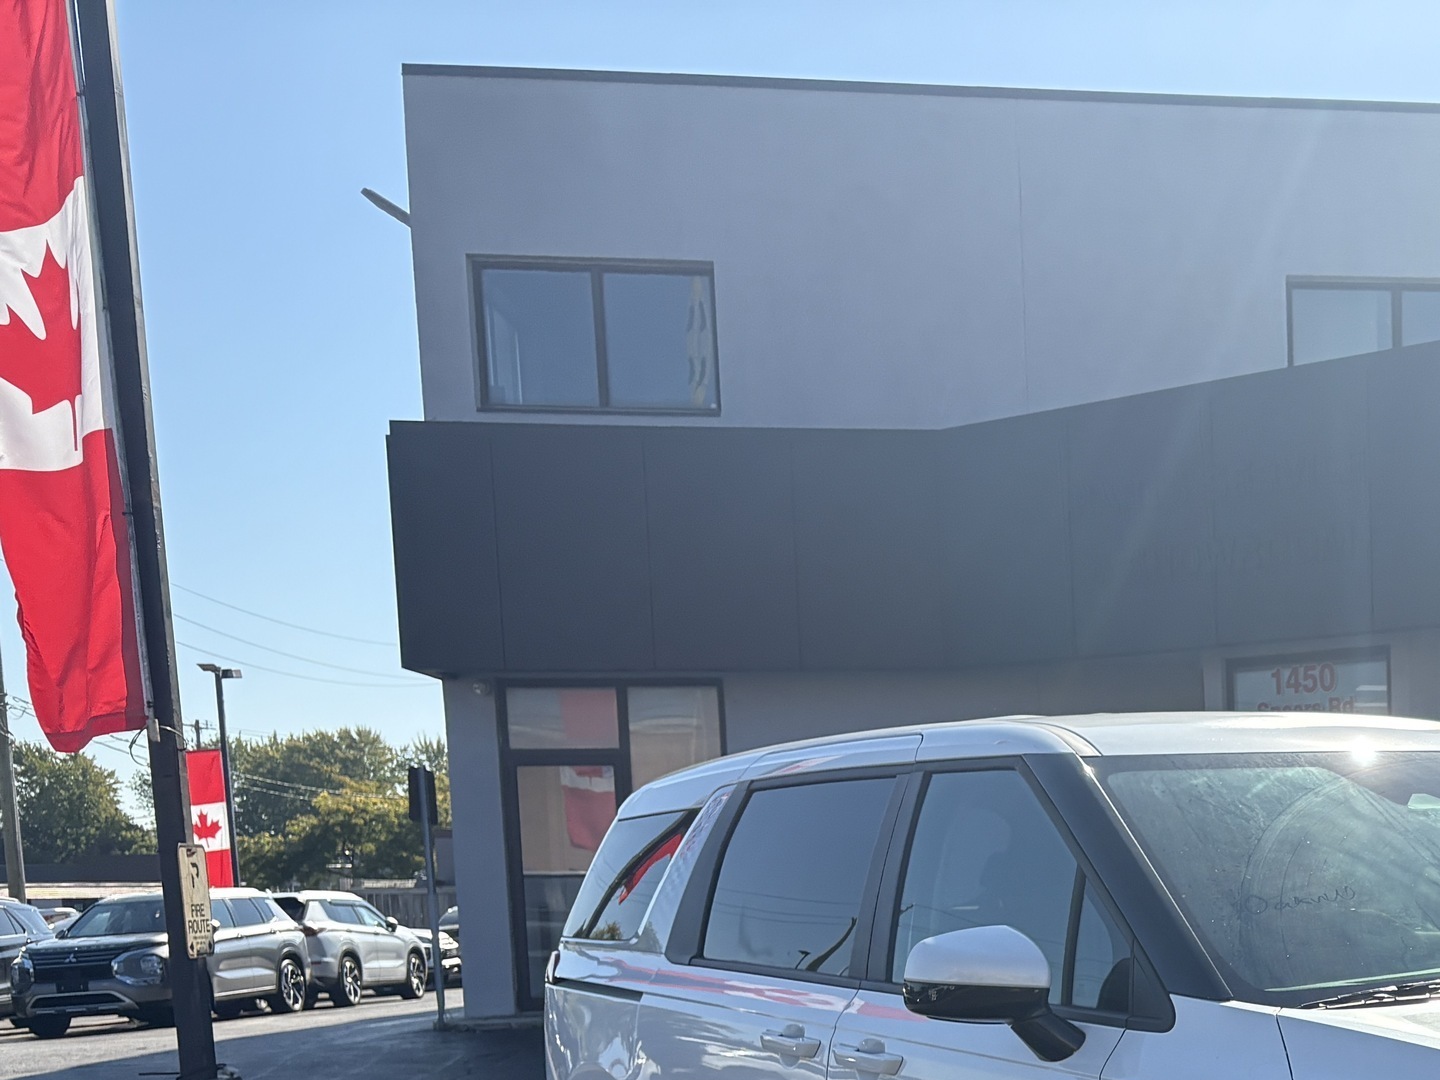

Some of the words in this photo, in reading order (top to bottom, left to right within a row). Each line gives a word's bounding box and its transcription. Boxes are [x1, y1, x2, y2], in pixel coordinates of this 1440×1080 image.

[1271, 663, 1336, 695] 1450
[1329, 696, 1354, 713] Rd
[191, 904, 205, 918] FIRE
[188, 919, 211, 935] ROUTE
